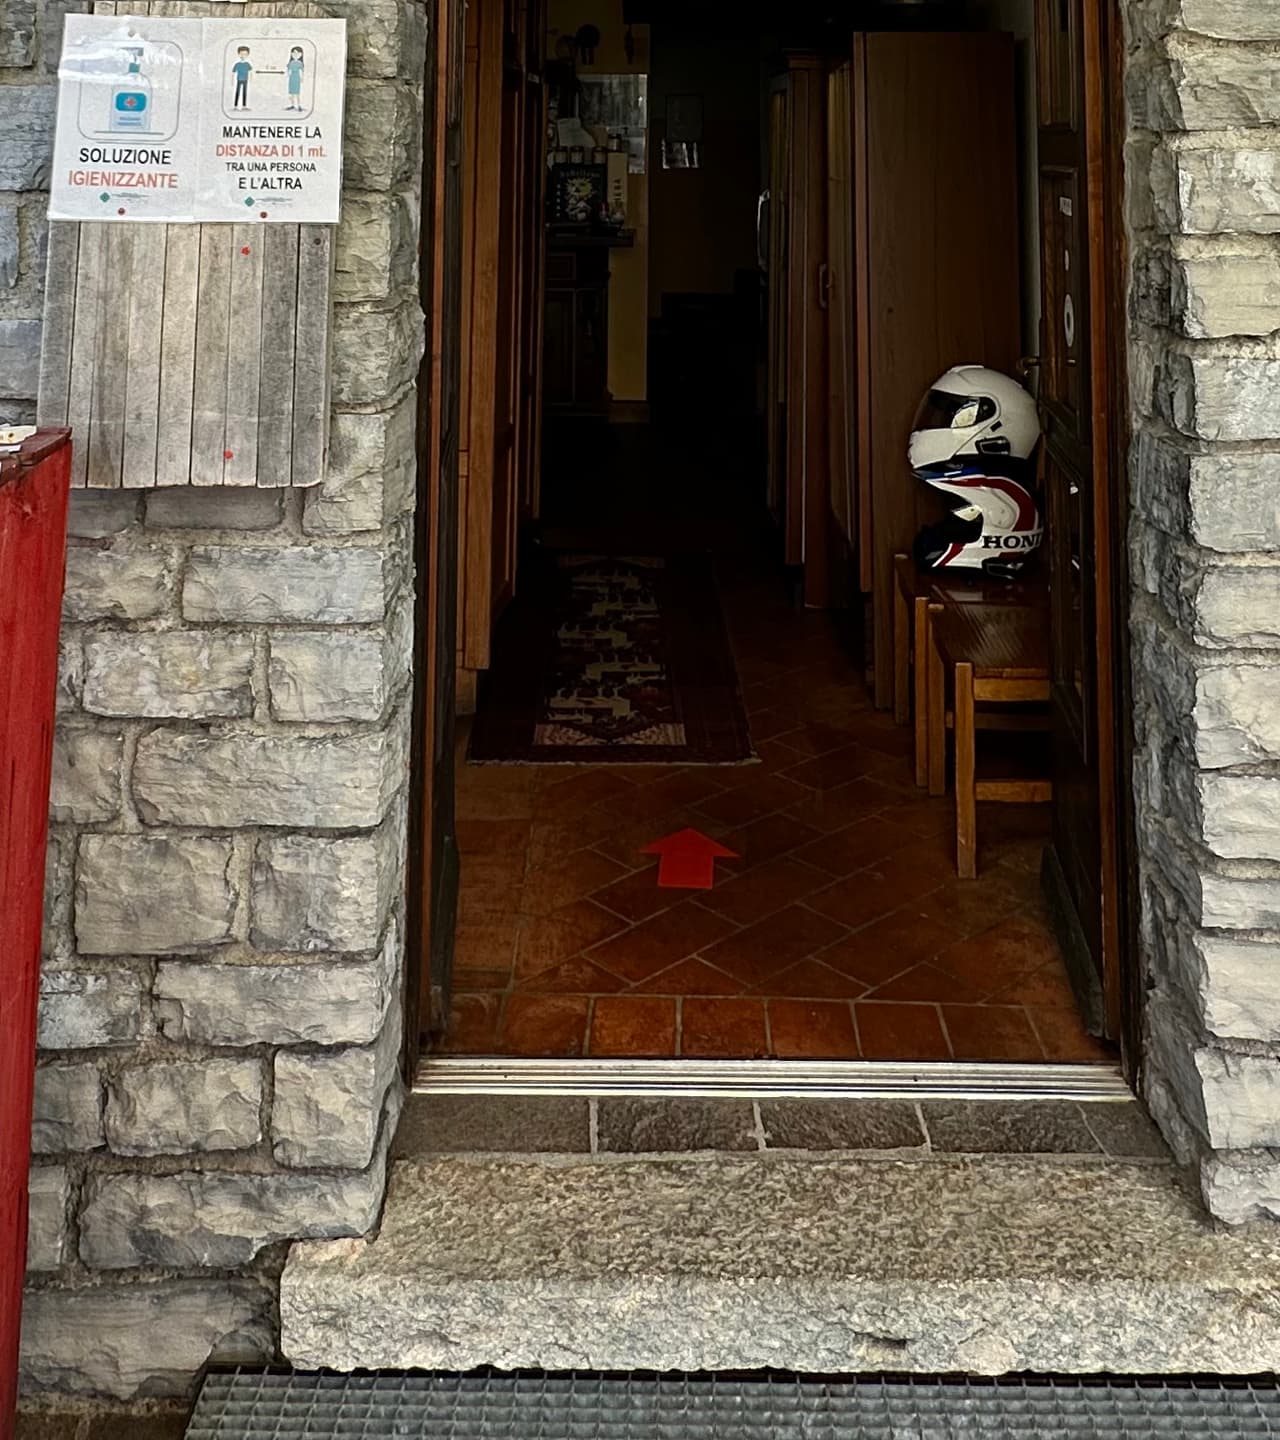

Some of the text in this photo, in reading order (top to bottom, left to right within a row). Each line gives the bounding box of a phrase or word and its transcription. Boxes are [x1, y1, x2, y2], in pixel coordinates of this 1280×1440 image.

[222, 126, 322, 139] MANTENERE LA
[79, 148, 171, 165] SOLUZIONE
[216, 145, 279, 157] DISTANZA
[281, 145, 294, 157] DI
[226, 162, 316, 172] TRA UNA PERSONA
[69, 171, 178, 188] IGIENIZZANTE
[238, 177, 302, 190] E L'ALTRA
